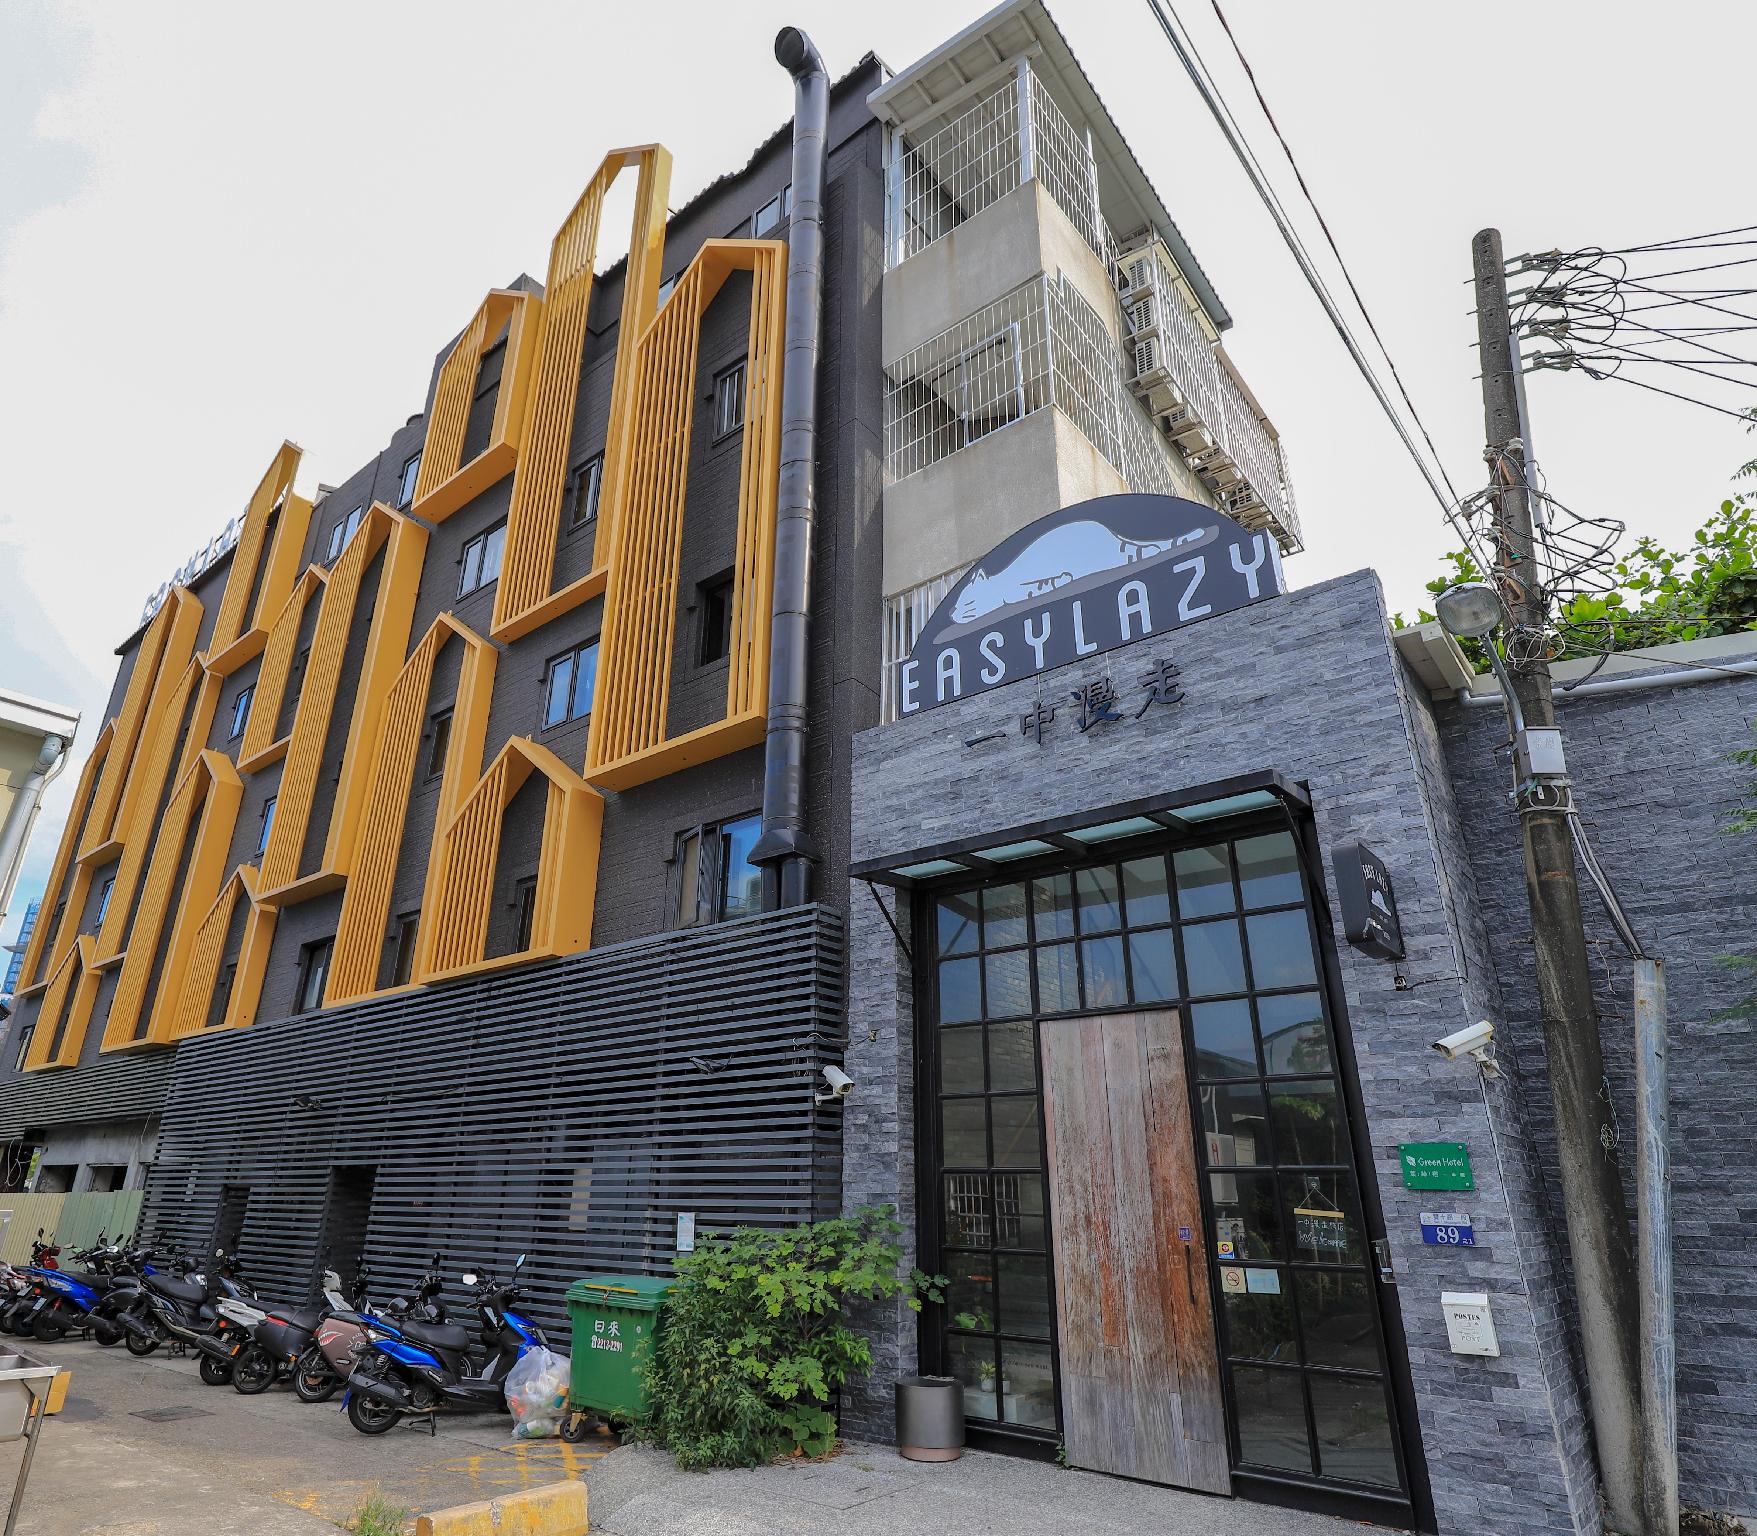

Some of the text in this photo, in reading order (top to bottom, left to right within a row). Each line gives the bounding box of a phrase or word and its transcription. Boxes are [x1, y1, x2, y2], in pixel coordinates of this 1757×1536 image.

[902, 534, 1266, 714] EASYLAZY
[1418, 1157, 1464, 1167] Green Hotel
[1436, 1226, 1460, 1244] 89
[1453, 1312, 1481, 1321] POSTES
